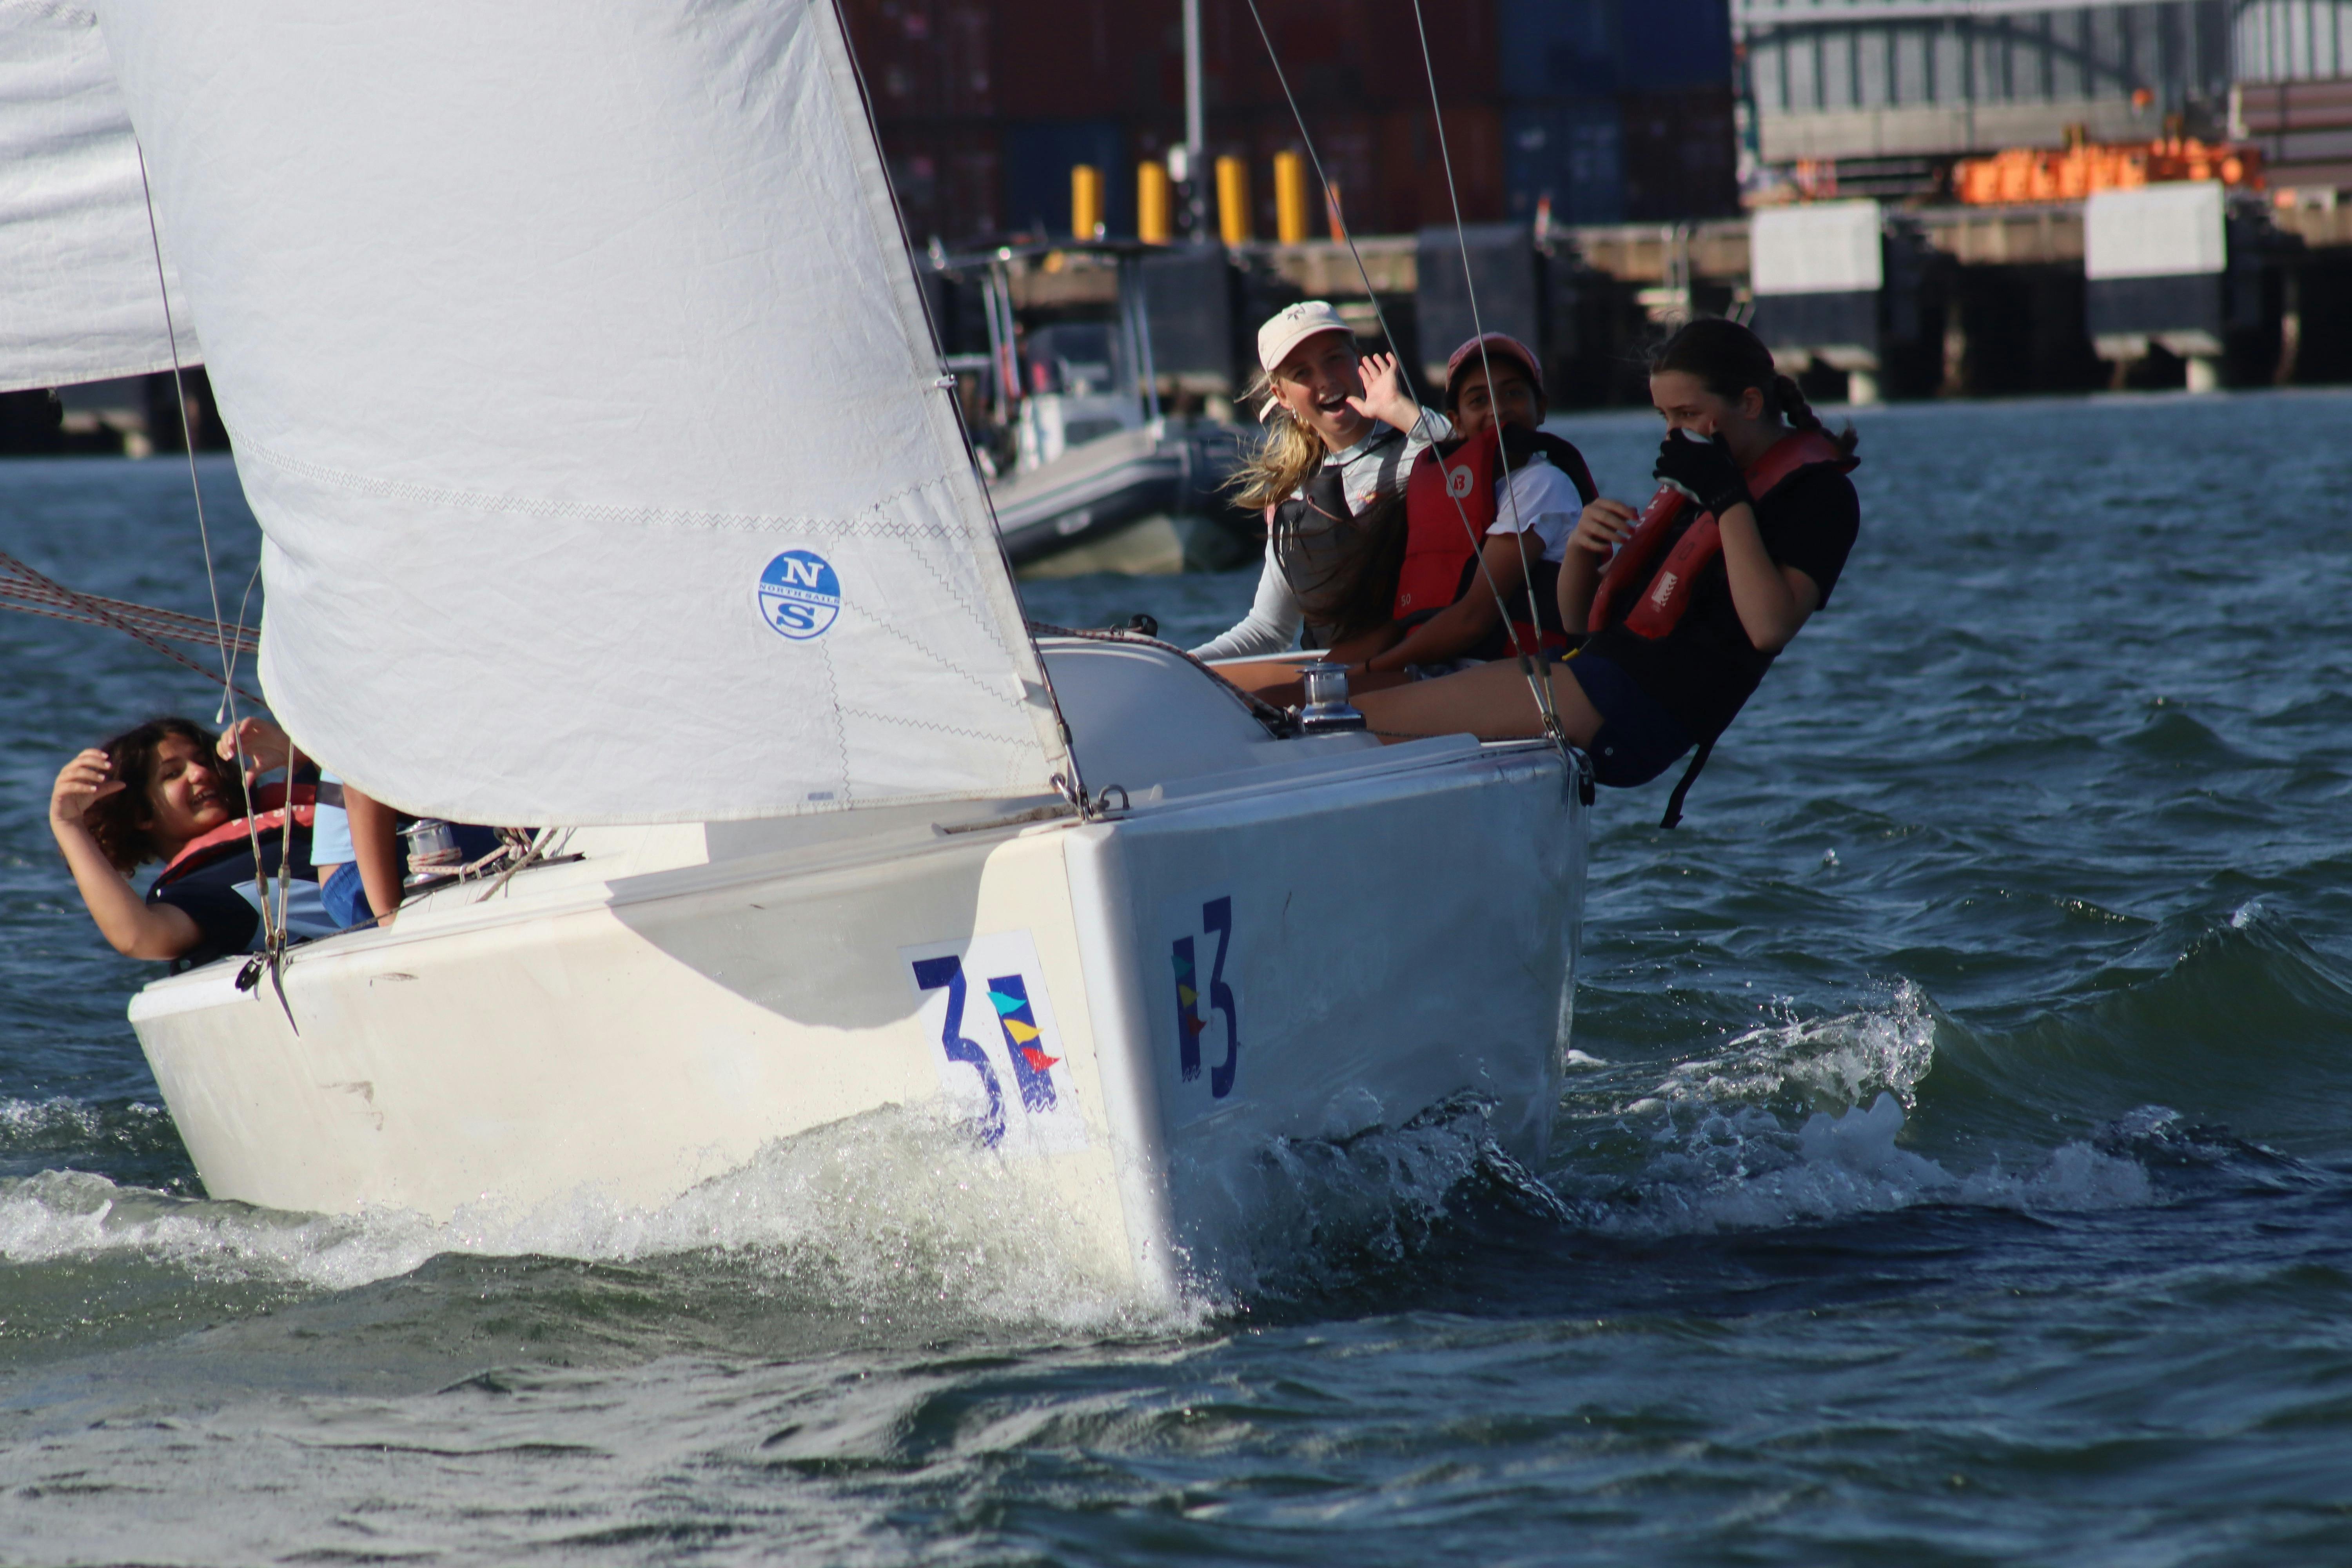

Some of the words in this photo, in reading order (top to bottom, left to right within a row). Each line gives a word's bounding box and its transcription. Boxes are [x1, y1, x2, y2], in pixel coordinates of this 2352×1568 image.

[781, 557, 824, 588] N
[759, 583, 801, 597] NORTH
[805, 592, 840, 605] SAILS
[1401, 593, 1411, 607] 50
[776, 603, 815, 629] S
